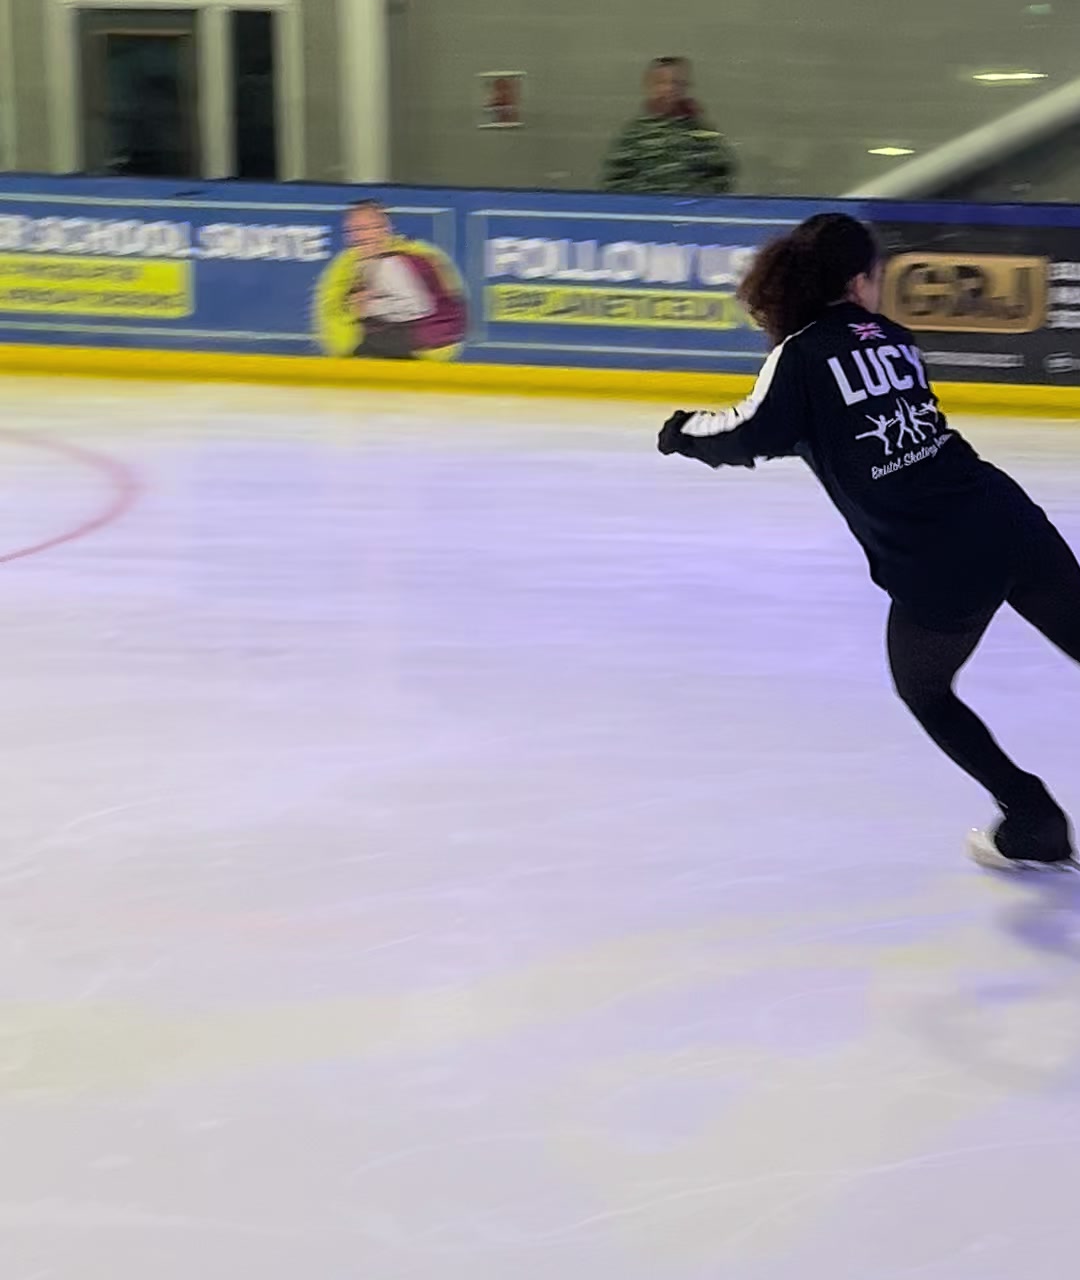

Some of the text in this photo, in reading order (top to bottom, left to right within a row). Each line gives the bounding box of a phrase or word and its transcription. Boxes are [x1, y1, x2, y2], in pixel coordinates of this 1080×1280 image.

[198, 223, 331, 261] SKATE
[487, 237, 698, 283] FOLLOW
[827, 344, 928, 406] LUCY
[871, 445, 938, 480] Bristol Skating
